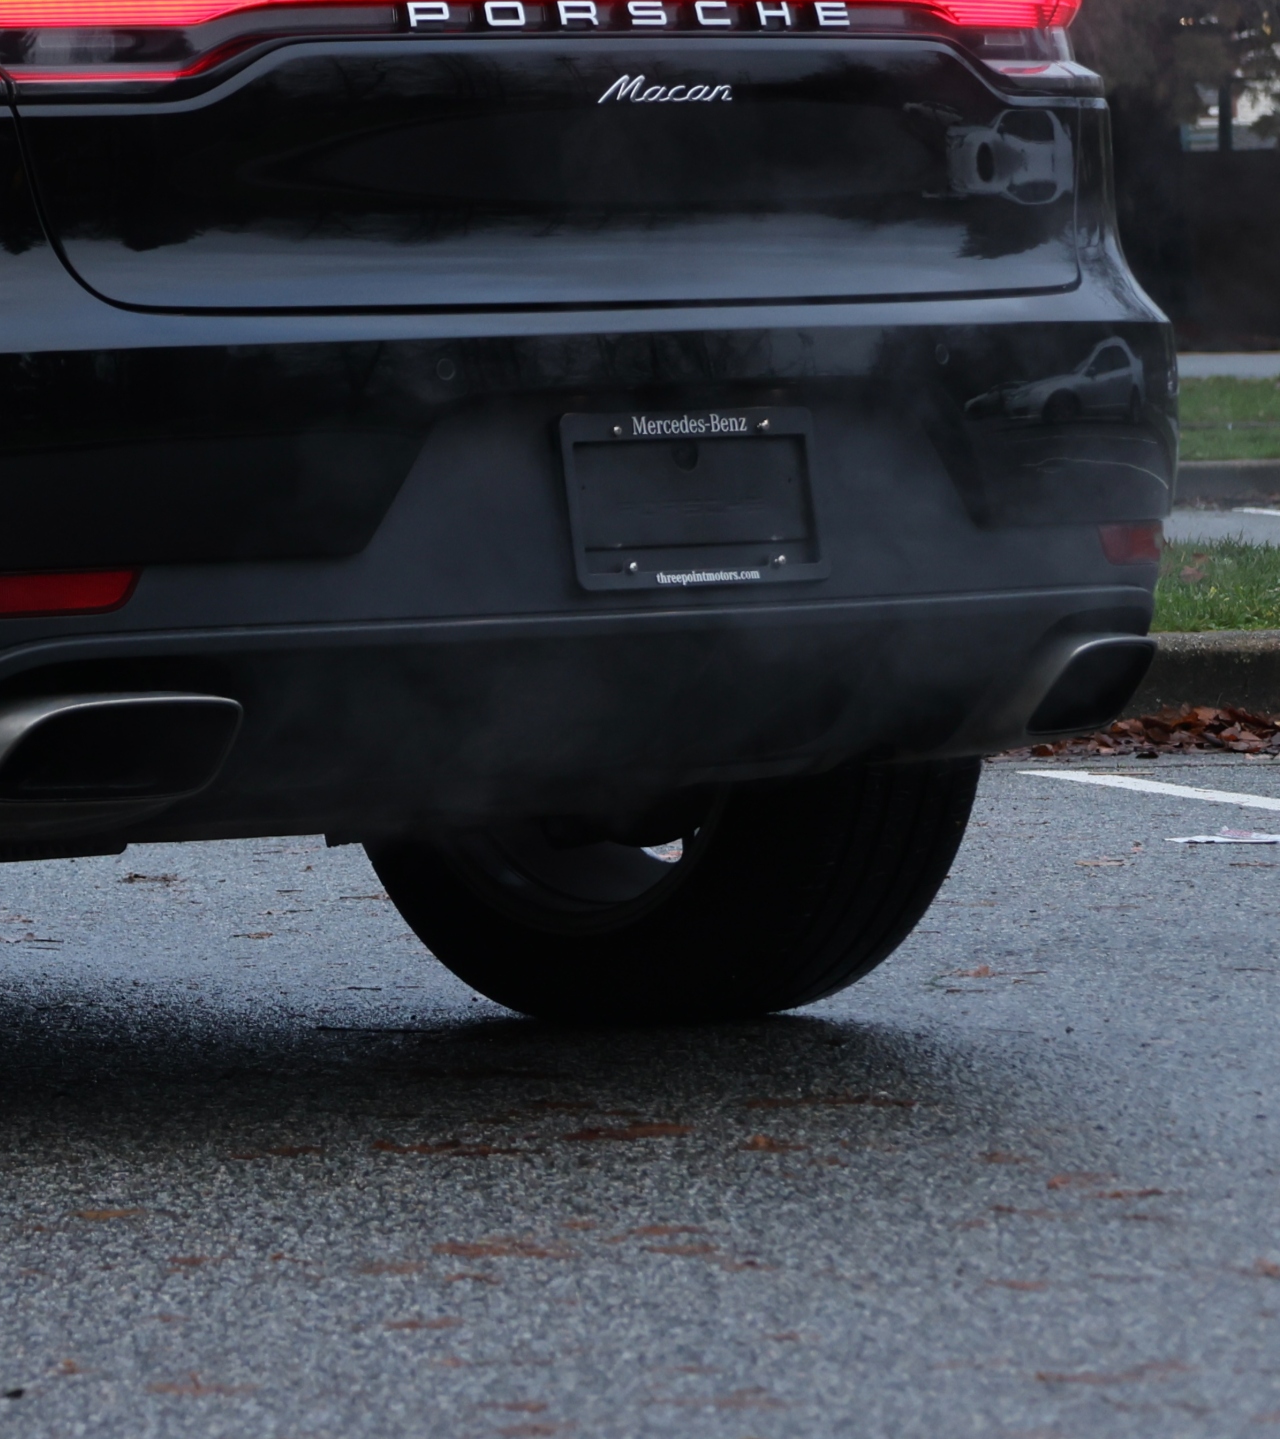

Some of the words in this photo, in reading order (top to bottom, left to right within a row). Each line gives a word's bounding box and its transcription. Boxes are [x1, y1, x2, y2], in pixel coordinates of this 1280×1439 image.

[407, 0, 850, 27] PORSCHE
[598, 74, 732, 104] Macan
[631, 414, 748, 436] Mercedes-Benz
[656, 570, 761, 586] threepointmotors.com
